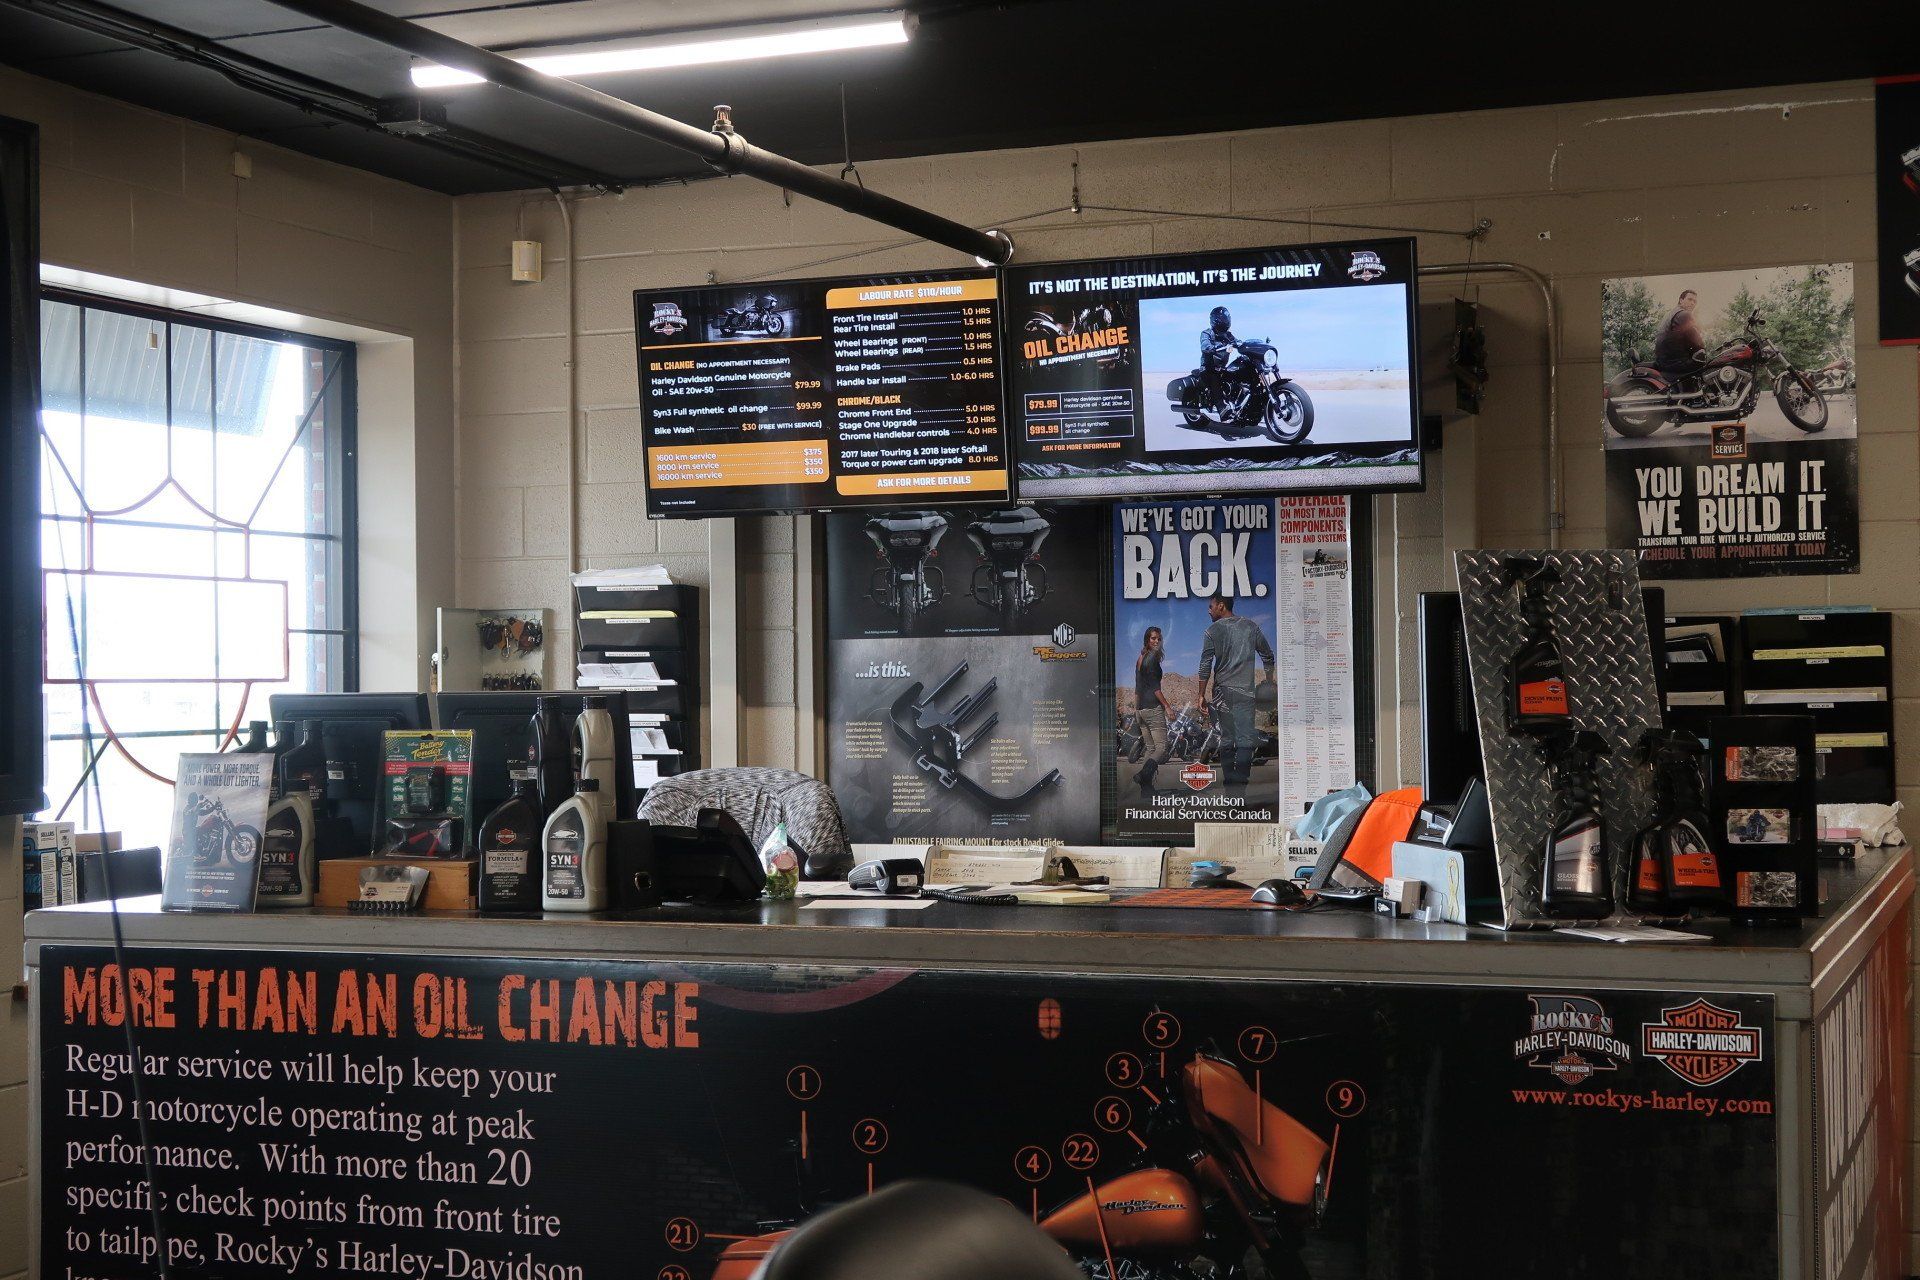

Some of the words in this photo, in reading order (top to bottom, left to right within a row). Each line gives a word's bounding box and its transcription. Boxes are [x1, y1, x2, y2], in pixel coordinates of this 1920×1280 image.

[1029, 282, 1052, 294] IT'S
[1056, 280, 1082, 293] NOT
[1085, 278, 1108, 290] THE
[1111, 271, 1200, 289] DESTINATION,
[1202, 269, 1228, 283] IT'S
[1230, 268, 1256, 282] THE
[1259, 264, 1321, 280] JOURNEY
[860, 291, 891, 300] LABOUR
[894, 290, 914, 298] RATE
[918, 286, 962, 298] $110/HOUR
[1024, 340, 1052, 359] OIL
[1056, 326, 1129, 354] CHANGE
[650, 361, 662, 371] OIL
[664, 360, 695, 370] CHANGE
[696, 361, 708, 369] (NO
[708, 360, 752, 368] APPOINTMENT
[752, 358, 790, 366] NECESSARY)
[1048, 353, 1086, 364] APPOINTMENT
[1086, 348, 1119, 359] NECESSARY
[836, 364, 858, 372] Brake
[652, 377, 676, 386] Harley
[678, 375, 713, 384] Davidson
[714, 373, 748, 382] Genuine
[748, 371, 791, 382] Motorcycle
[652, 388, 663, 396] Oil
[686, 386, 714, 394] 20w-50
[794, 380, 820, 390] $79.99
[838, 395, 901, 406] CHROME/BLACK
[1028, 400, 1058, 410] $79.99
[896, 408, 911, 416] End
[672, 426, 694, 434] Wash
[742, 423, 756, 432] $30
[794, 420, 822, 428] SERVICE)
[1030, 426, 1058, 435] $99.99
[1715, 444, 1744, 454] SERVICE
[878, 478, 893, 488] ASK
[896, 478, 911, 486] FOR
[914, 476, 936, 486] MORE
[938, 476, 971, 485] DETAILS
[1636, 466, 1682, 498] YOU
[1696, 462, 1784, 496] DREAM
[1800, 460, 1827, 492] IT.
[1121, 508, 1174, 532] WE'VE
[1181, 506, 1216, 530] GOT
[1222, 504, 1268, 530] YOUR
[1280, 509, 1290, 519] ON
[1294, 508, 1316, 518] MOST
[1319, 508, 1346, 518] MAJOR
[1638, 500, 1682, 536] WE
[1699, 496, 1781, 534] BUILD
[1798, 494, 1828, 531] IT.
[1281, 520, 1346, 534] COMPONENTS,
[1281, 535, 1300, 544] PARTS
[1303, 534, 1315, 543] AND
[1318, 534, 1346, 542] SYSTEMS
[1638, 536, 1678, 546] TRANSFORM
[1681, 536, 1698, 545] YOUR
[1700, 535, 1715, 544] BIKE
[1719, 534, 1737, 544] WITH
[1739, 534, 1752, 542] H-D
[1754, 533, 1795, 542] AUTHORIZED
[1798, 532, 1826, 541] SERVICE
[1643, 548, 1686, 560] CHEDULE
[1690, 546, 1716, 559] YOUR
[1721, 544, 1788, 558] APPOINTMENT
[1794, 542, 1826, 556] TODAY
[1124, 532, 1268, 598] BACK.
[882, 661, 911, 678] this.
[1152, 796, 1244, 807] Harley-Davidson
[1126, 808, 1174, 820] Financial
[1178, 808, 1226, 820] Services
[1229, 808, 1271, 820] Canada
[892, 838, 934, 846] ADJUSTABLE
[936, 838, 963, 846] FAIRING
[964, 838, 990, 846] MOUNT
[992, 838, 1002, 846] for
[1003, 838, 1022, 846] stock
[1023, 838, 1041, 846] Road
[1042, 838, 1064, 846] Glides
[1288, 847, 1318, 855] SELLARS
[263, 852, 294, 862] SYN3
[551, 855, 578, 865] SYN3
[548, 888, 568, 896] 20W-50
[63, 964, 176, 1028] MORE
[192, 968, 316, 1034] THAN
[332, 969, 397, 1038] AN
[413, 972, 484, 1040] OIL
[498, 974, 699, 1048] CHANGE
[1157, 1019, 1168, 1040] 5
[1532, 1011, 1613, 1034] ROCKY'S
[1676, 1012, 1728, 1028] MOTOR
[1251, 1034, 1264, 1054] 7
[1515, 1031, 1630, 1058] HARLEY-DAVIDSON
[1652, 1032, 1752, 1052] HARLEY-DAVIDSON
[178, 1050, 272, 1080] service
[281, 1052, 334, 1082] will
[343, 1054, 402, 1093] help
[412, 1057, 480, 1097] keep
[490, 1068, 556, 1098] your
[1119, 1060, 1130, 1080] 3
[1676, 1056, 1728, 1078] CYCLES
[800, 1072, 808, 1092] 1
[1340, 1088, 1352, 1108] 9
[1512, 1088, 1772, 1117] www.rockys-harley.com
[66, 1089, 122, 1118] H-D
[132, 1096, 282, 1132] motorcycle
[291, 1102, 422, 1142] operating
[432, 1110, 457, 1136] at
[466, 1108, 536, 1144] peak
[1107, 1104, 1120, 1124] 6
[864, 1126, 876, 1146] 2
[66, 1135, 240, 1170] performance.
[258, 1143, 326, 1174] With
[336, 1154, 407, 1180] more
[416, 1152, 477, 1184] than
[487, 1148, 532, 1186] 20
[1068, 1140, 1094, 1162] 22
[1026, 1153, 1039, 1173] 4
[176, 1184, 255, 1217] check
[262, 1190, 346, 1226] points
[356, 1194, 423, 1228] from
[434, 1200, 502, 1233] front
[512, 1205, 560, 1237] tire
[670, 1224, 692, 1244] 21
[66, 1226, 90, 1252] to
[100, 1225, 206, 1266] tailppe,
[214, 1232, 328, 1274] Rocky's
[338, 1240, 583, 1280] Harley-Davidson
